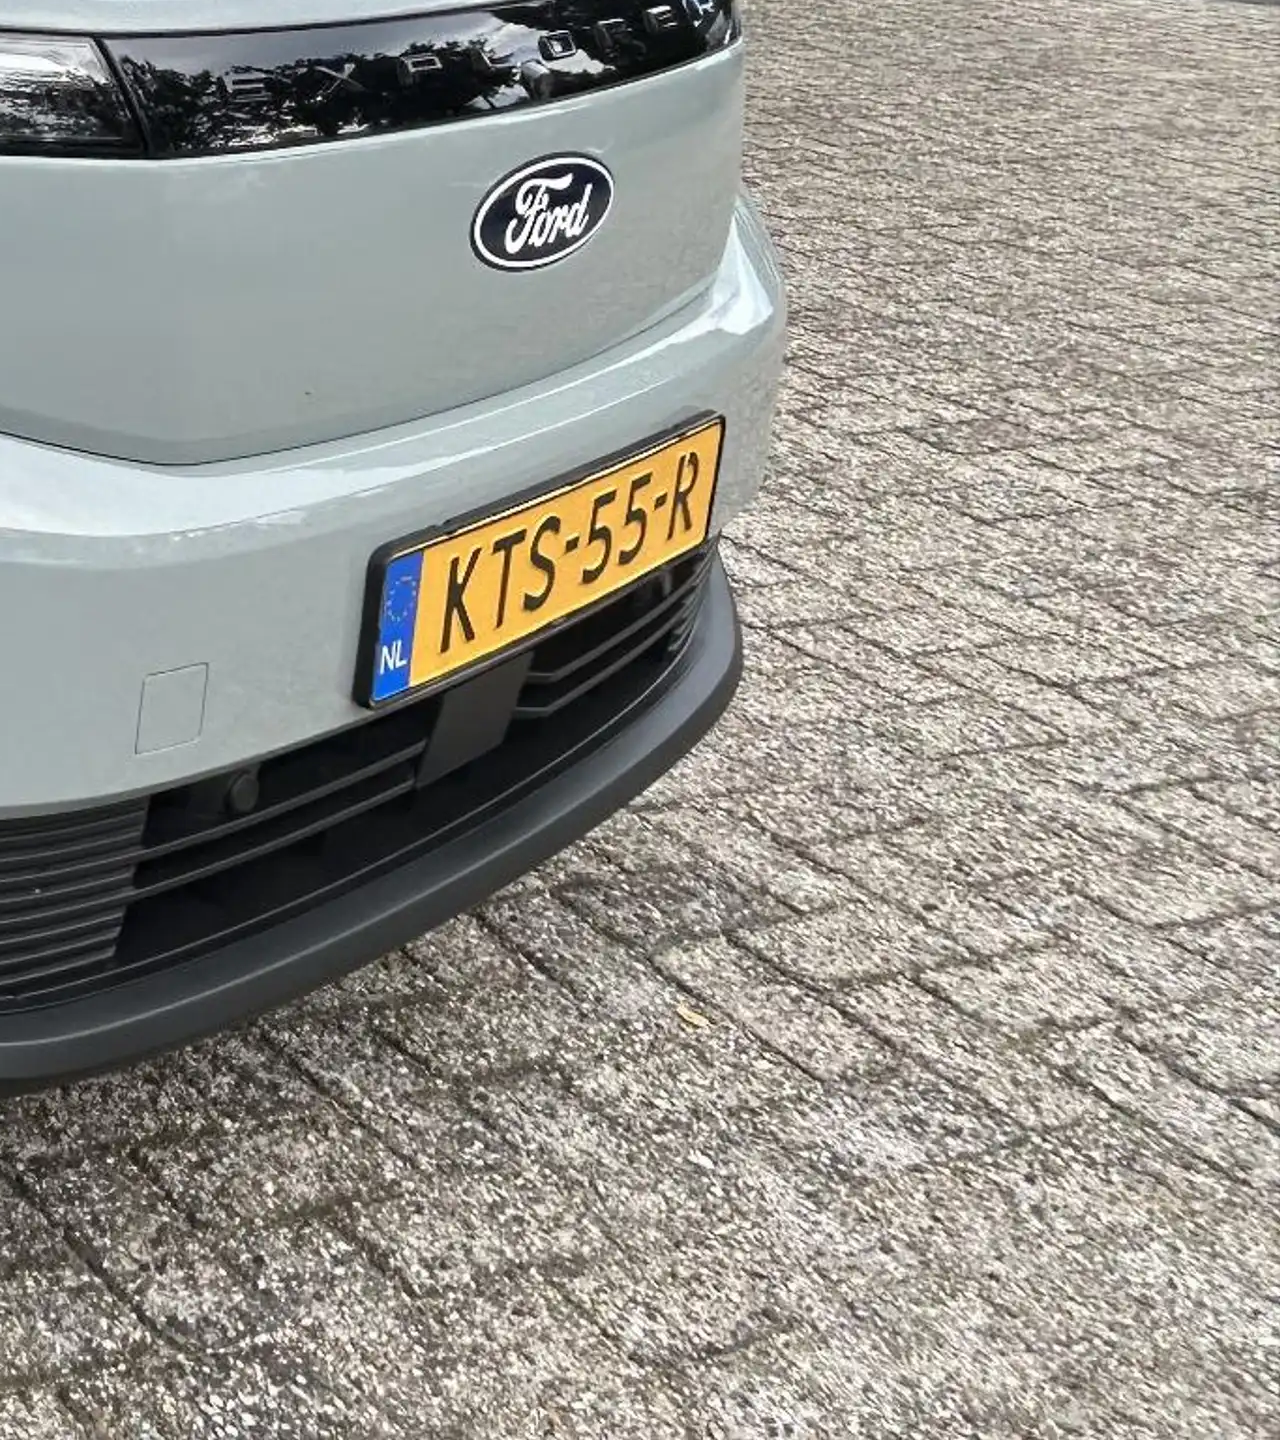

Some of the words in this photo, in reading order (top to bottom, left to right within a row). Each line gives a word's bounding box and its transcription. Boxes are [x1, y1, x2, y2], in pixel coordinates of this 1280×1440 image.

[503, 175, 592, 255] Ford
[439, 451, 699, 654] KTS-55-R
[378, 641, 408, 676] NL
